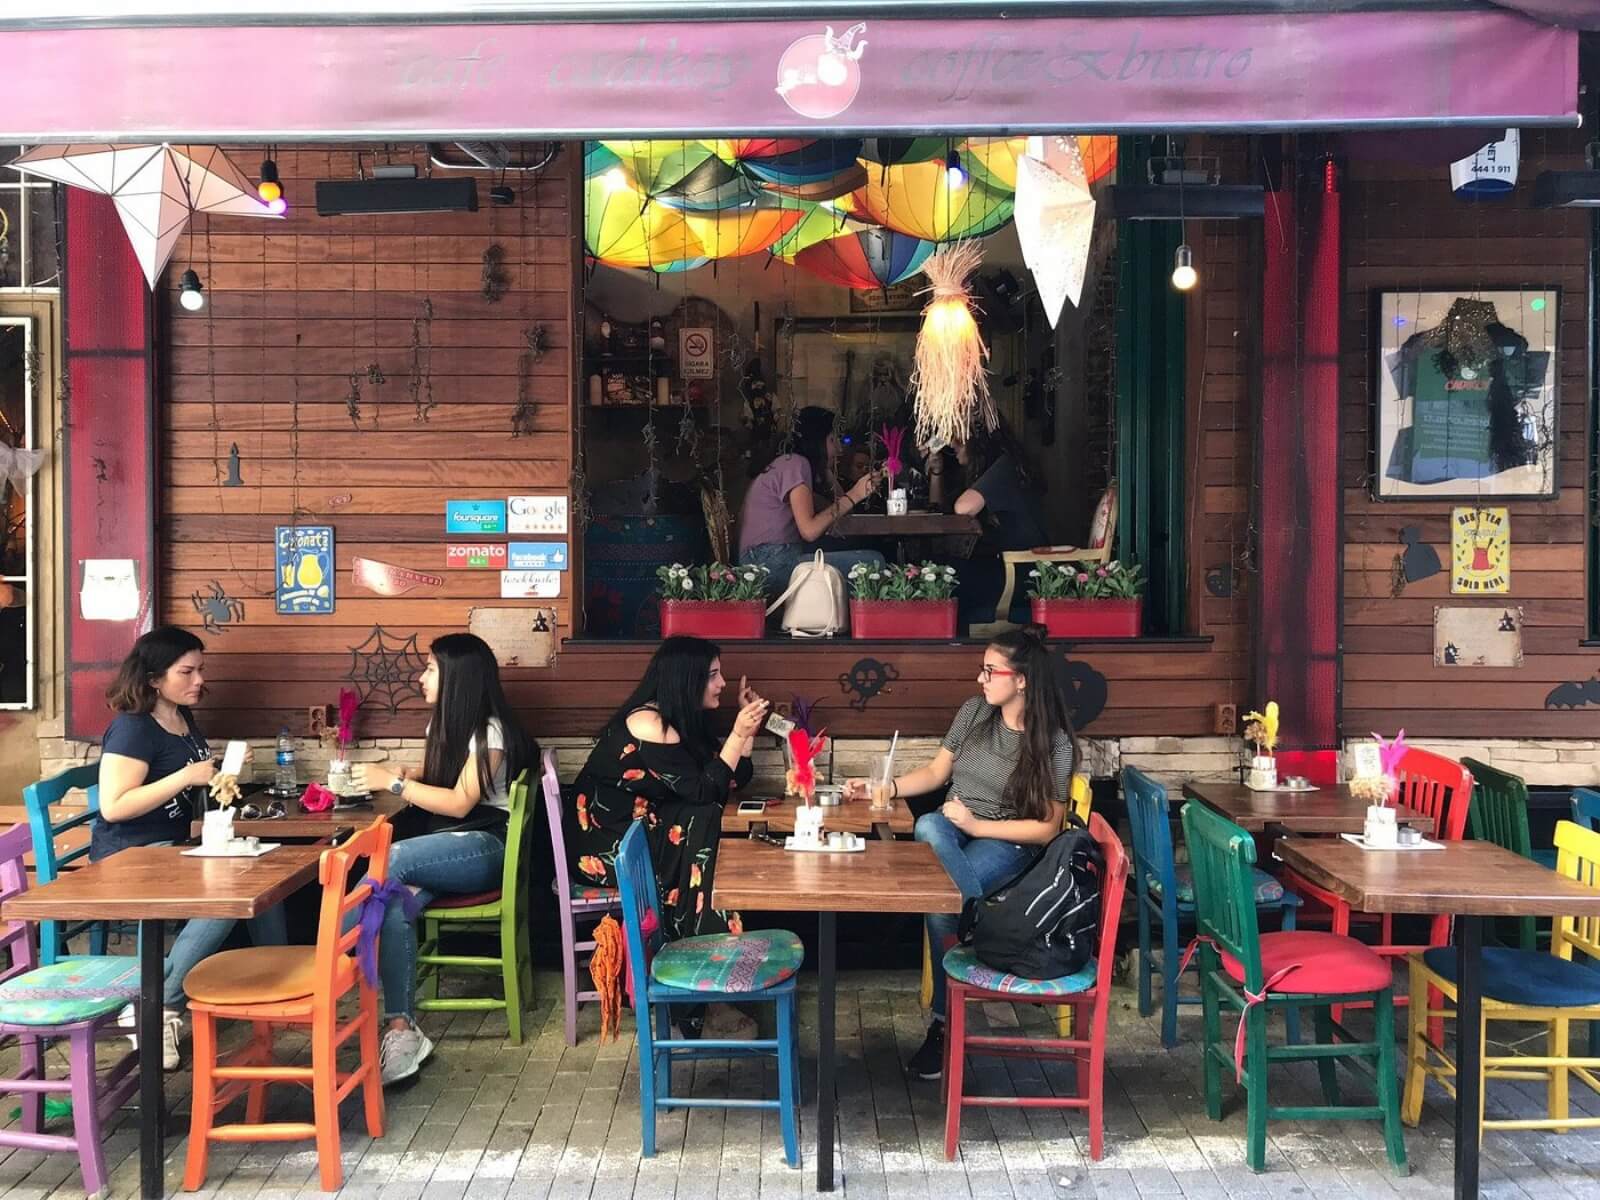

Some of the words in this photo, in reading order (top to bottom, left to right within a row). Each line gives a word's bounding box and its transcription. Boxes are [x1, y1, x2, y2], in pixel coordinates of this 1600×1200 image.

[1471, 165, 1489, 173] 444
[1497, 165, 1511, 174] 911
[453, 511, 499, 523] foursquare
[279, 530, 329, 551] Lonata
[448, 544, 505, 557] zomato
